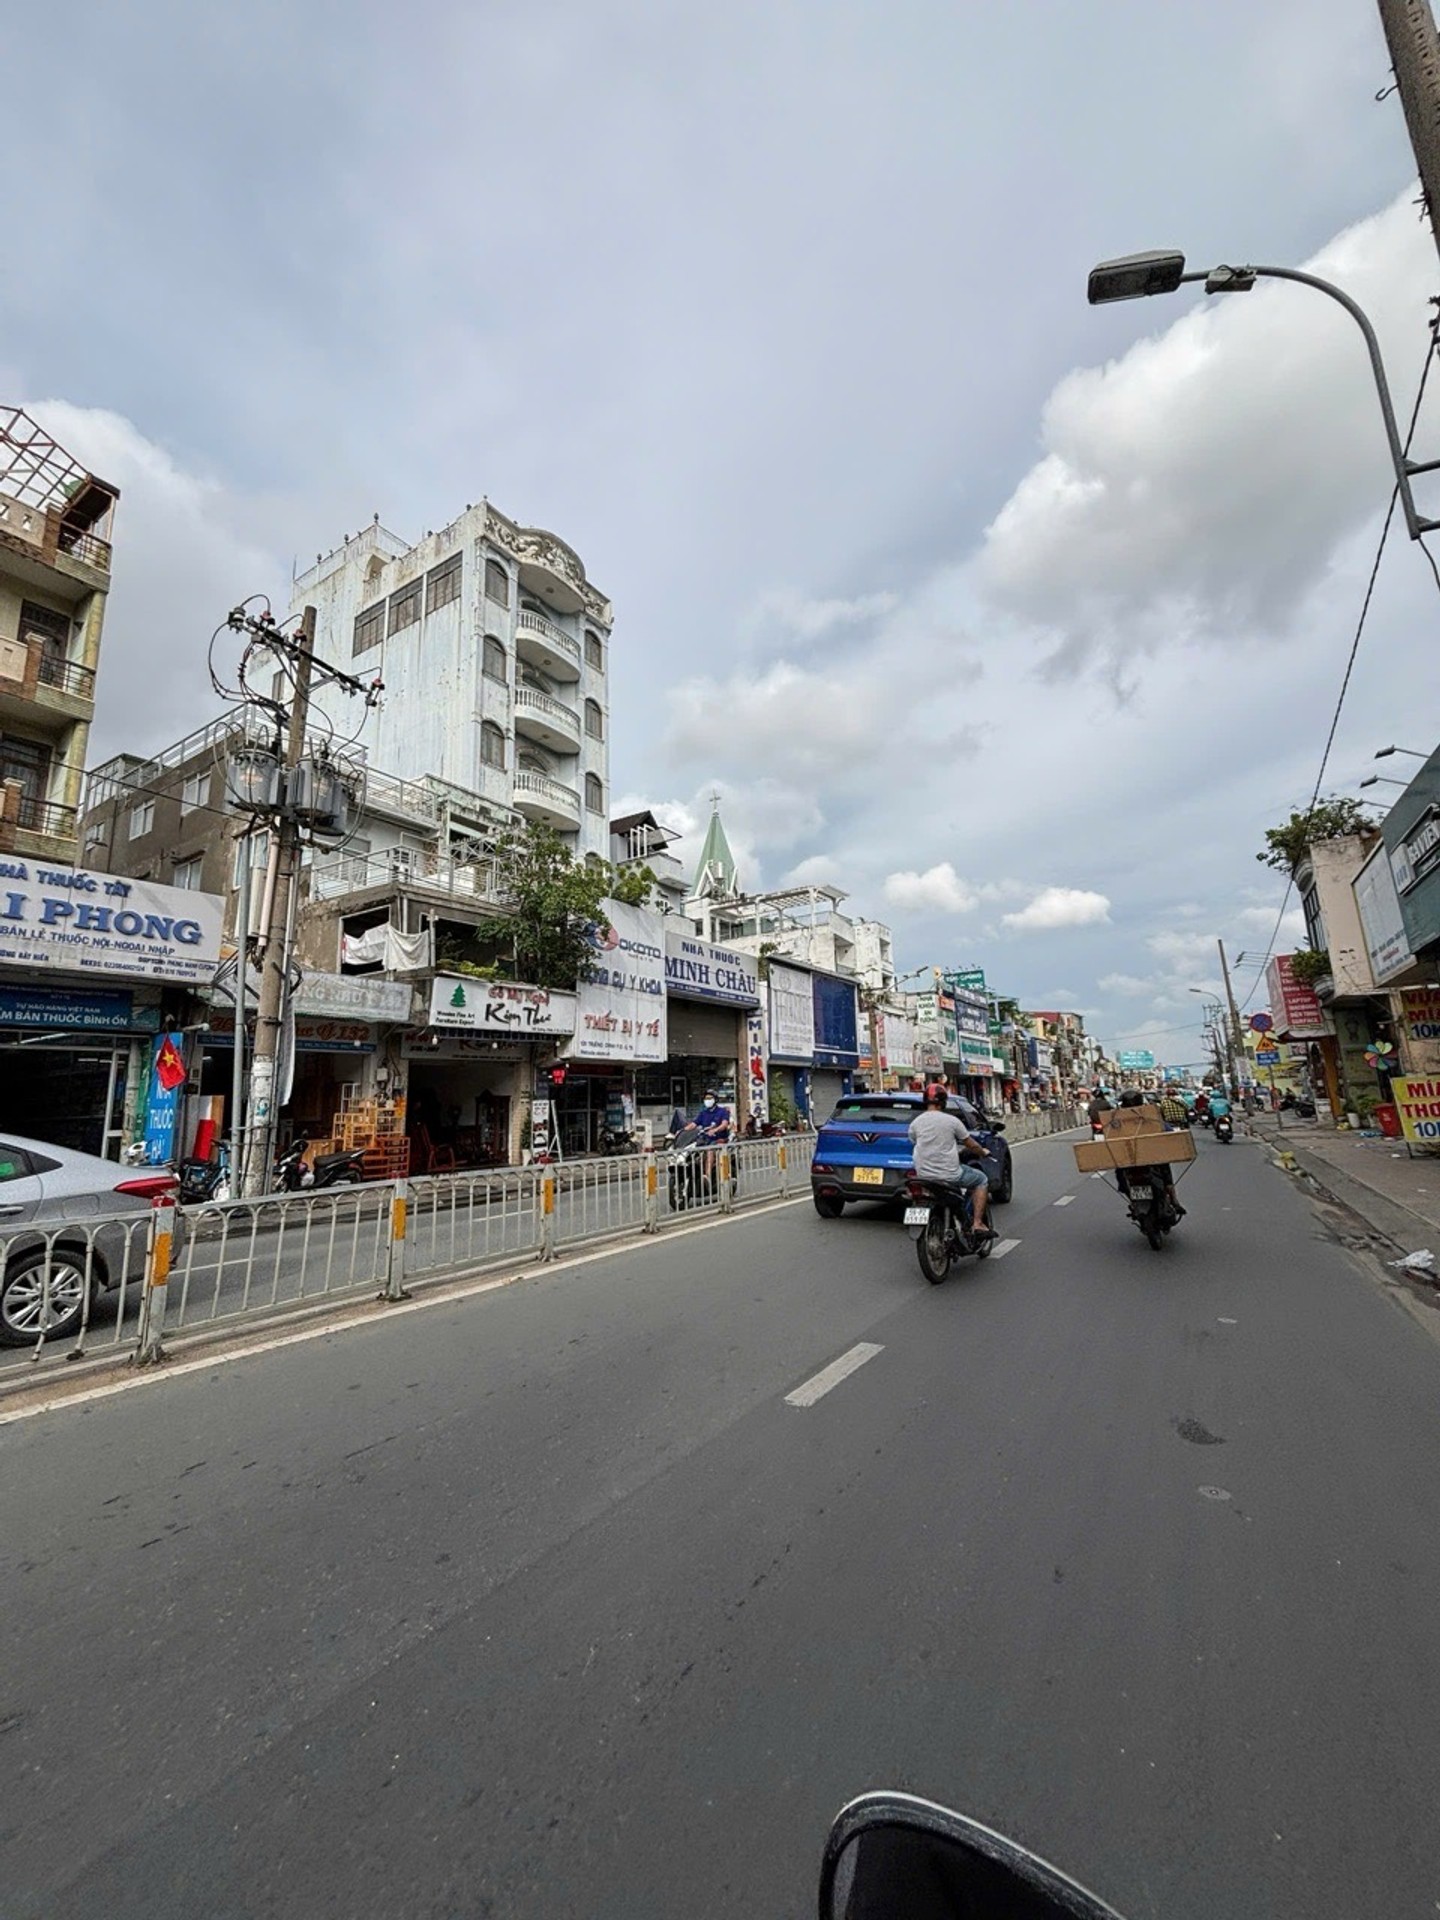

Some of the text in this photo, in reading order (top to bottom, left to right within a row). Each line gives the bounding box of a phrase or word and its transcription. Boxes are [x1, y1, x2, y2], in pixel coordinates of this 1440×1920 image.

[37, 869, 98, 892] THUỐC
[104, 880, 132, 898] TÂY
[39, 897, 203, 945] PHONG
[50, 931, 90, 945] THUỐC
[148, 945, 176, 956] NHẬP
[630, 974, 637, 990] Y
[639, 976, 663, 995] KHOA
[665, 955, 710, 985] MINH
[715, 968, 756, 994] CHÂU
[42, 1011, 82, 1023] THUỐC
[84, 1013, 110, 1025] BÌNH
[485, 1003, 521, 1026] Kim
[584, 1010, 660, 1037] THIẾT BỊ Y TẾ
[1402, 1103, 1440, 1119] THƠ
